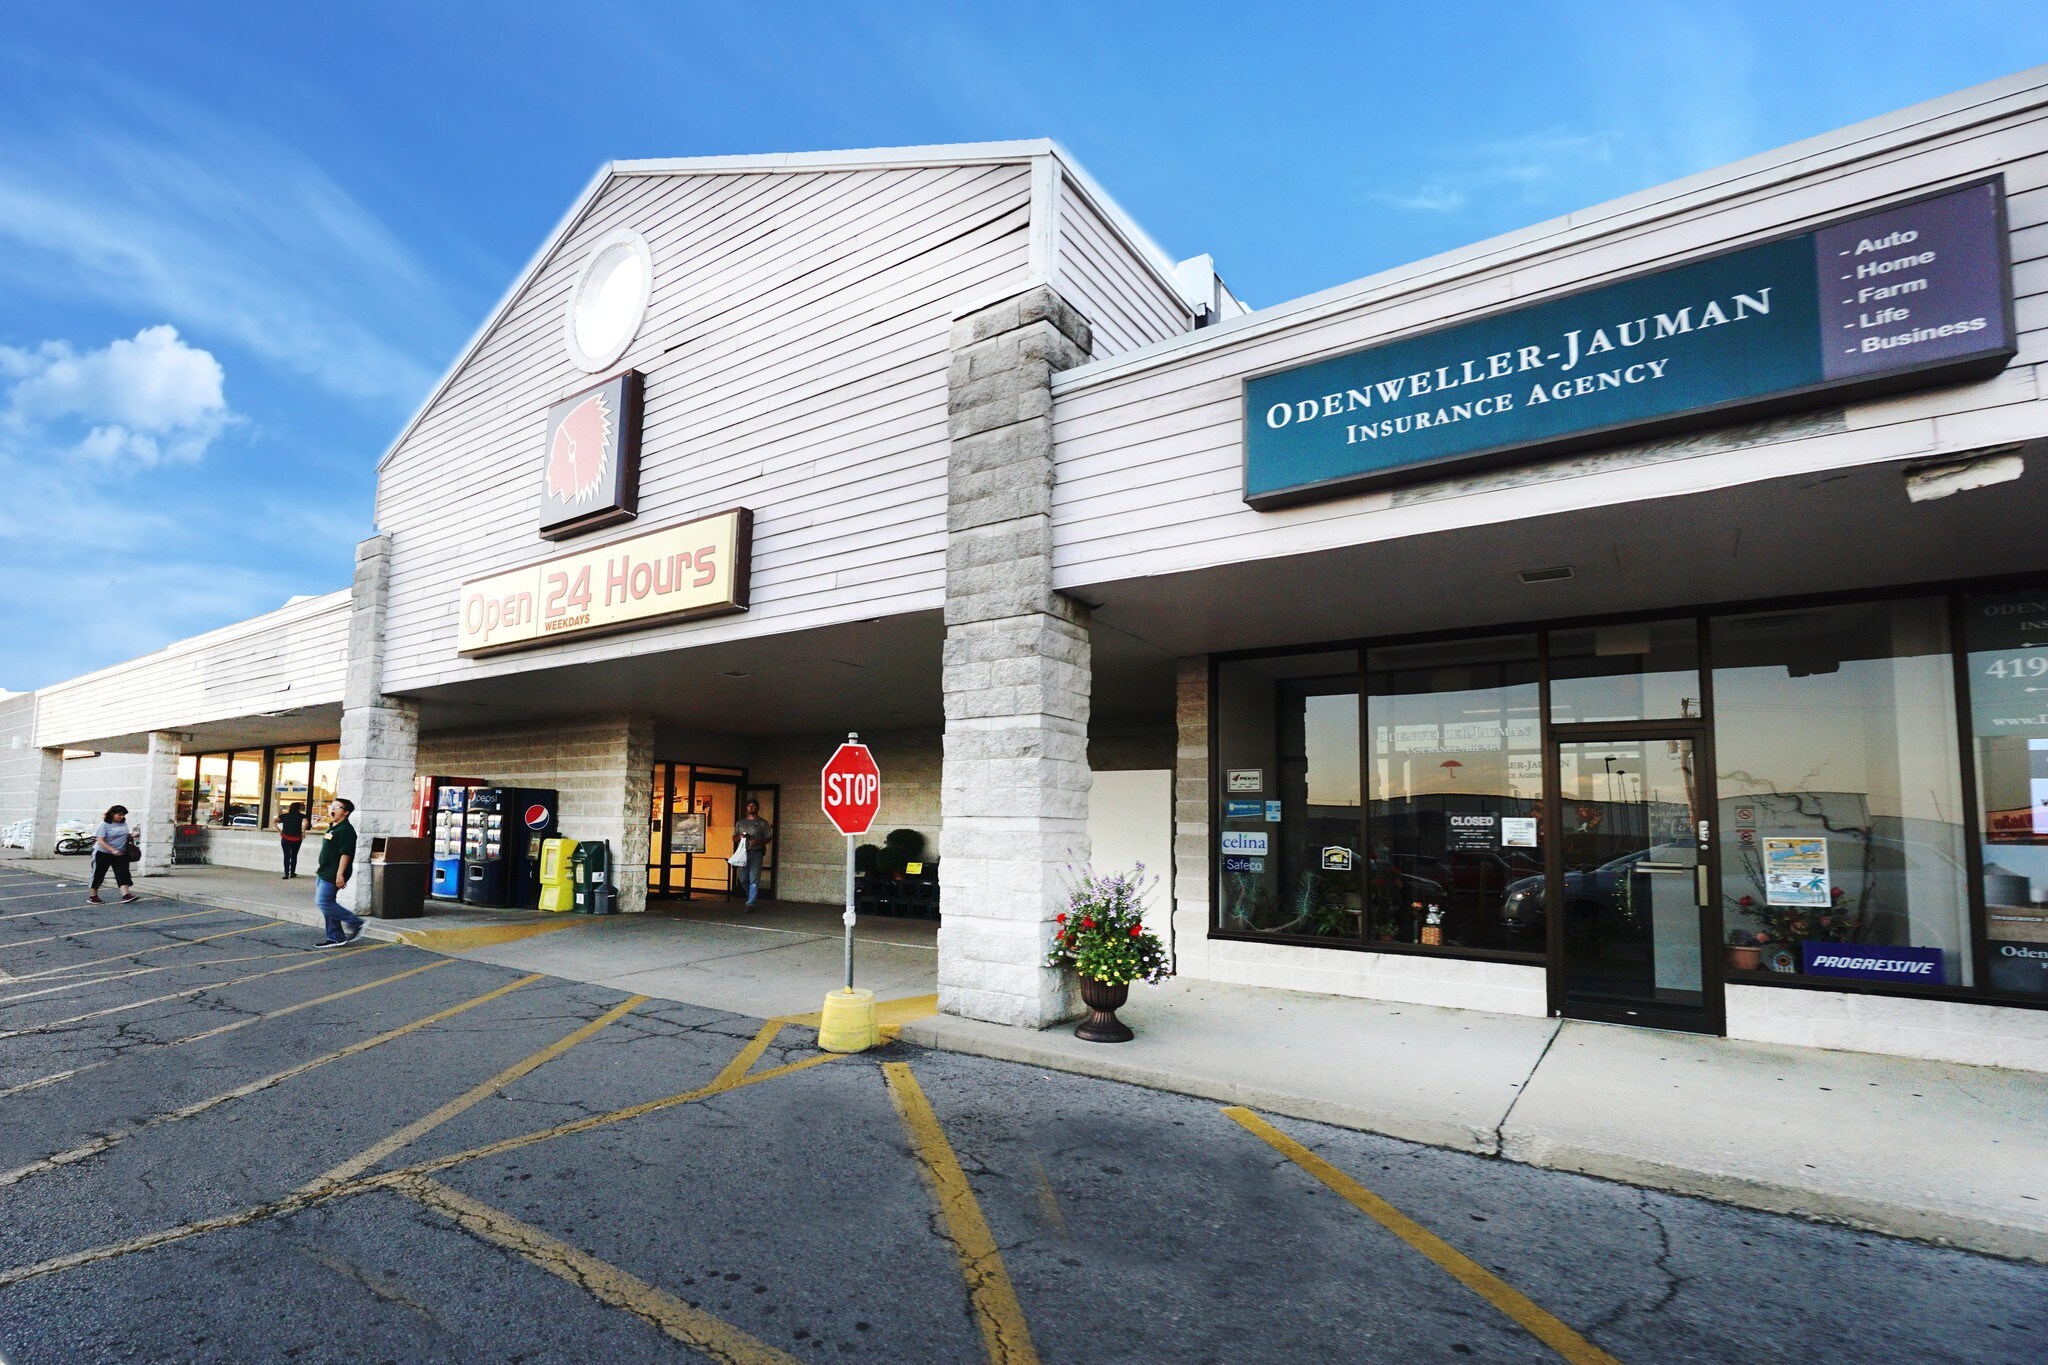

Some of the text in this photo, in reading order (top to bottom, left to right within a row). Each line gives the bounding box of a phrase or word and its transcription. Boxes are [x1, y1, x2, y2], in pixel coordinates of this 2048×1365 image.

[1855, 230, 1919, 256] Auto
[1856, 251, 1936, 280] Home
[1858, 278, 1928, 304] Farm
[1860, 307, 1910, 329] Life
[1861, 317, 1988, 354] Business
[1266, 287, 1772, 429] ODENWELLER-JAUMAN
[1346, 358, 1669, 445] INSURANCE AGENCY
[465, 545, 716, 642] Open 24 Hours
[544, 614, 591, 632] WEEKDAYS
[475, 792, 498, 804] pepsi
[828, 773, 877, 807] STOP
[1450, 816, 1494, 826] CLOSED
[1222, 834, 1266, 850] celina
[1226, 859, 1263, 872] Safeco
[1813, 955, 1935, 974] PROGRESSIVE
